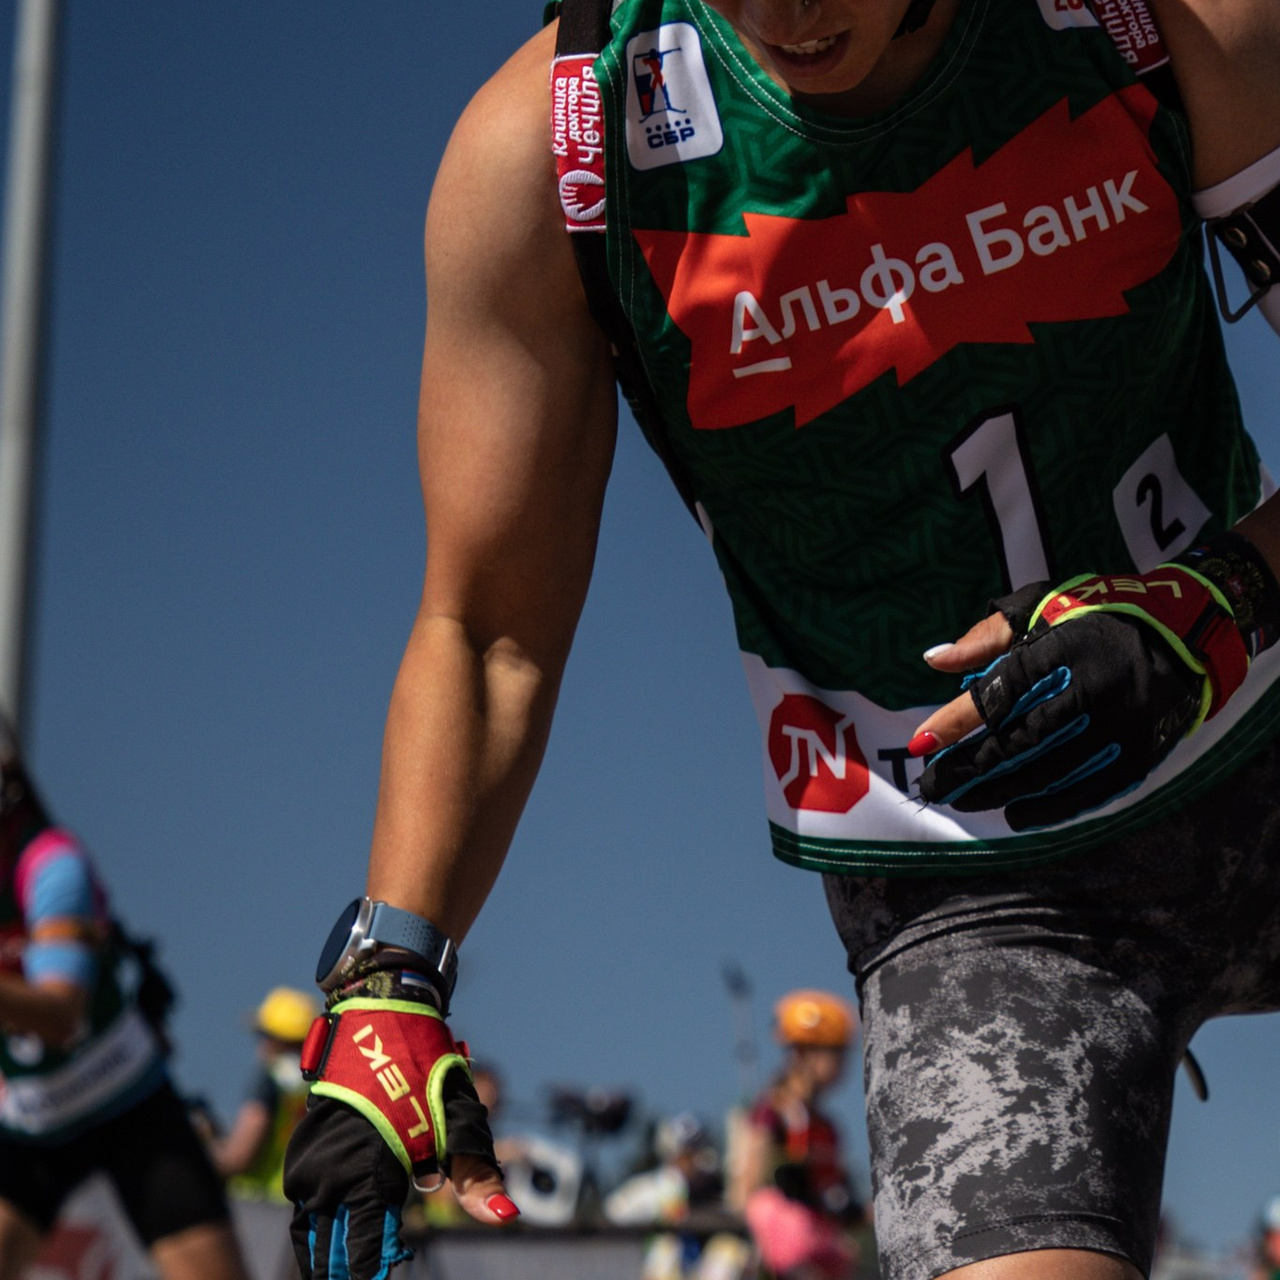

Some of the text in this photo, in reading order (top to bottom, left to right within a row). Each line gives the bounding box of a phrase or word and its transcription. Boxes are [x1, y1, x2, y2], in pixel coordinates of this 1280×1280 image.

[552, 77, 568, 157] Клиника
[568, 76, 582, 143] доктора
[646, 126, 696, 150] СБР
[729, 170, 1150, 355] Альфа Банк
[951, 412, 1051, 593] 1
[1135, 472, 1187, 552] 2
[1057, 577, 1183, 608] LEKI
[352, 1023, 430, 1139] LEKI
